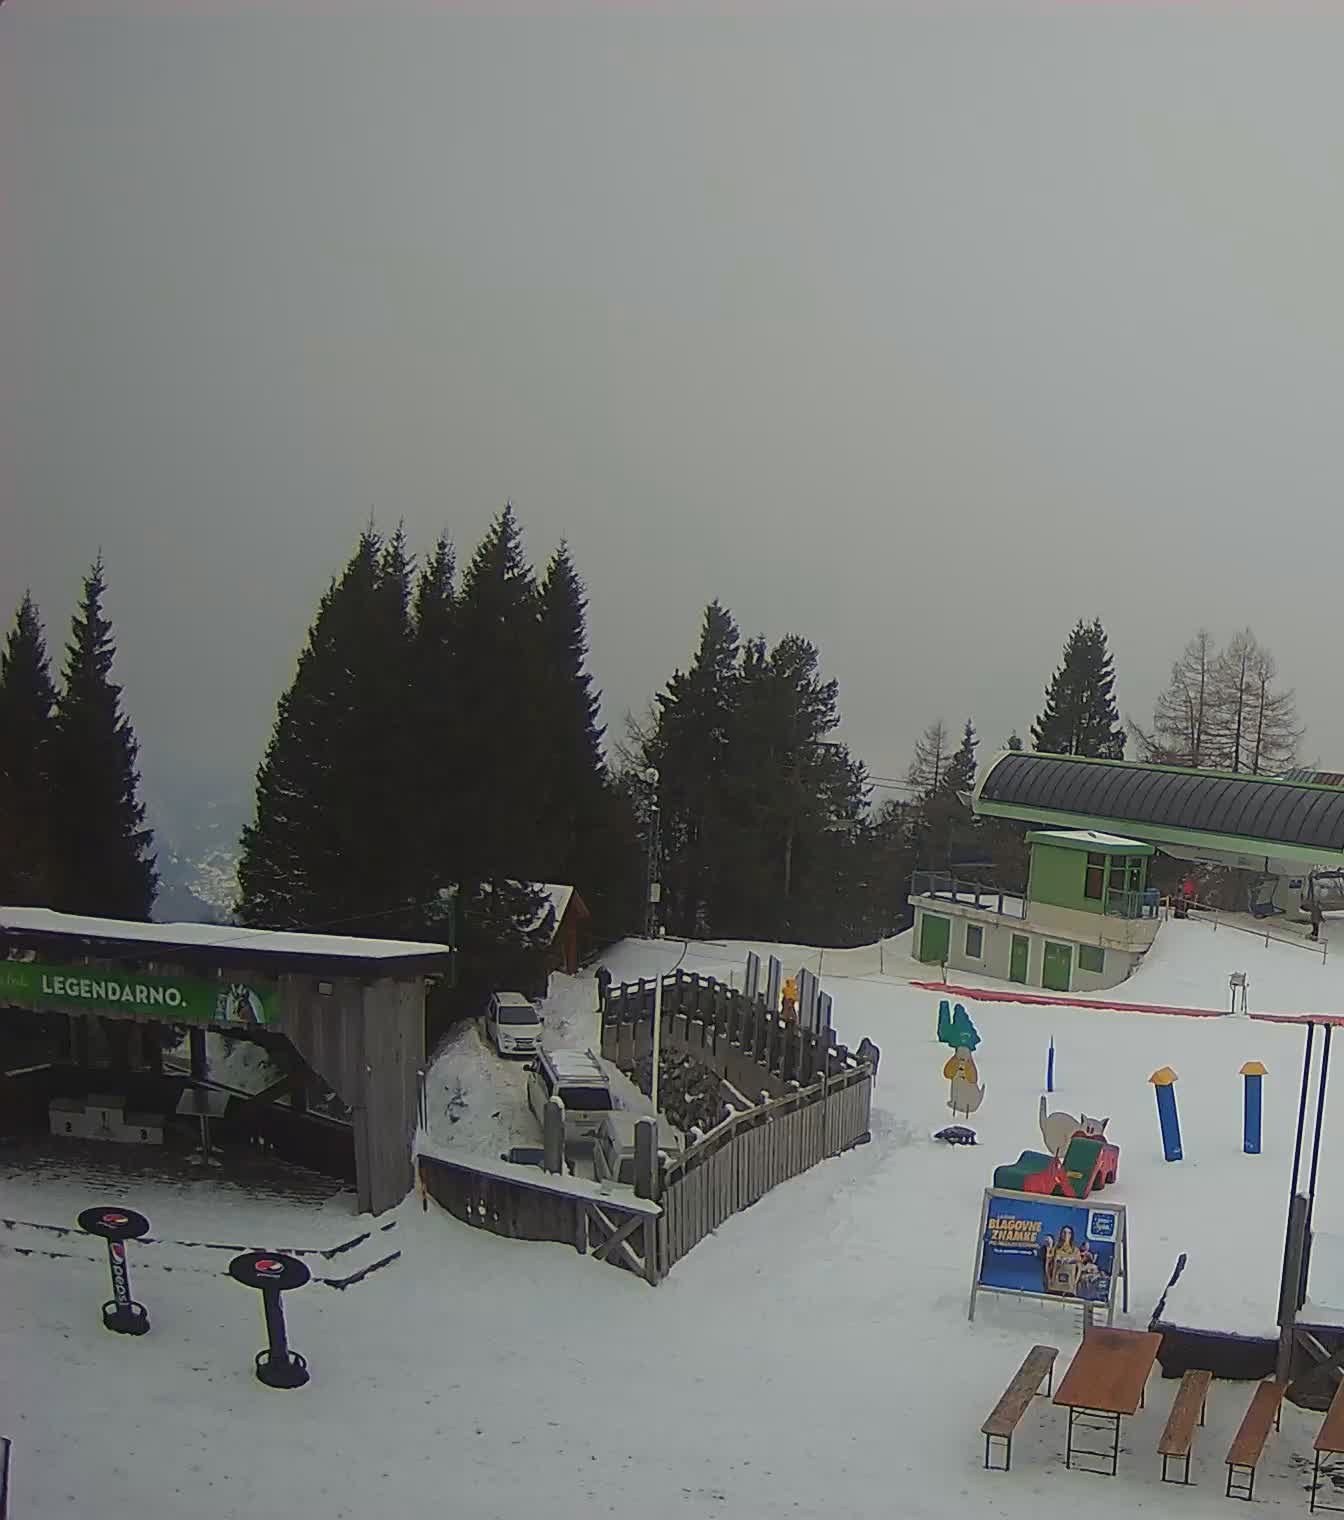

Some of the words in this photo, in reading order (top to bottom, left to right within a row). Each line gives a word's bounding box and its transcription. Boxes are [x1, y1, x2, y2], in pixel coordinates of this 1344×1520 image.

[42, 974, 188, 1008] LEGENDARNO.
[65, 1121, 73, 1133] 2
[991, 1229, 1038, 1242] ZNAMKE
